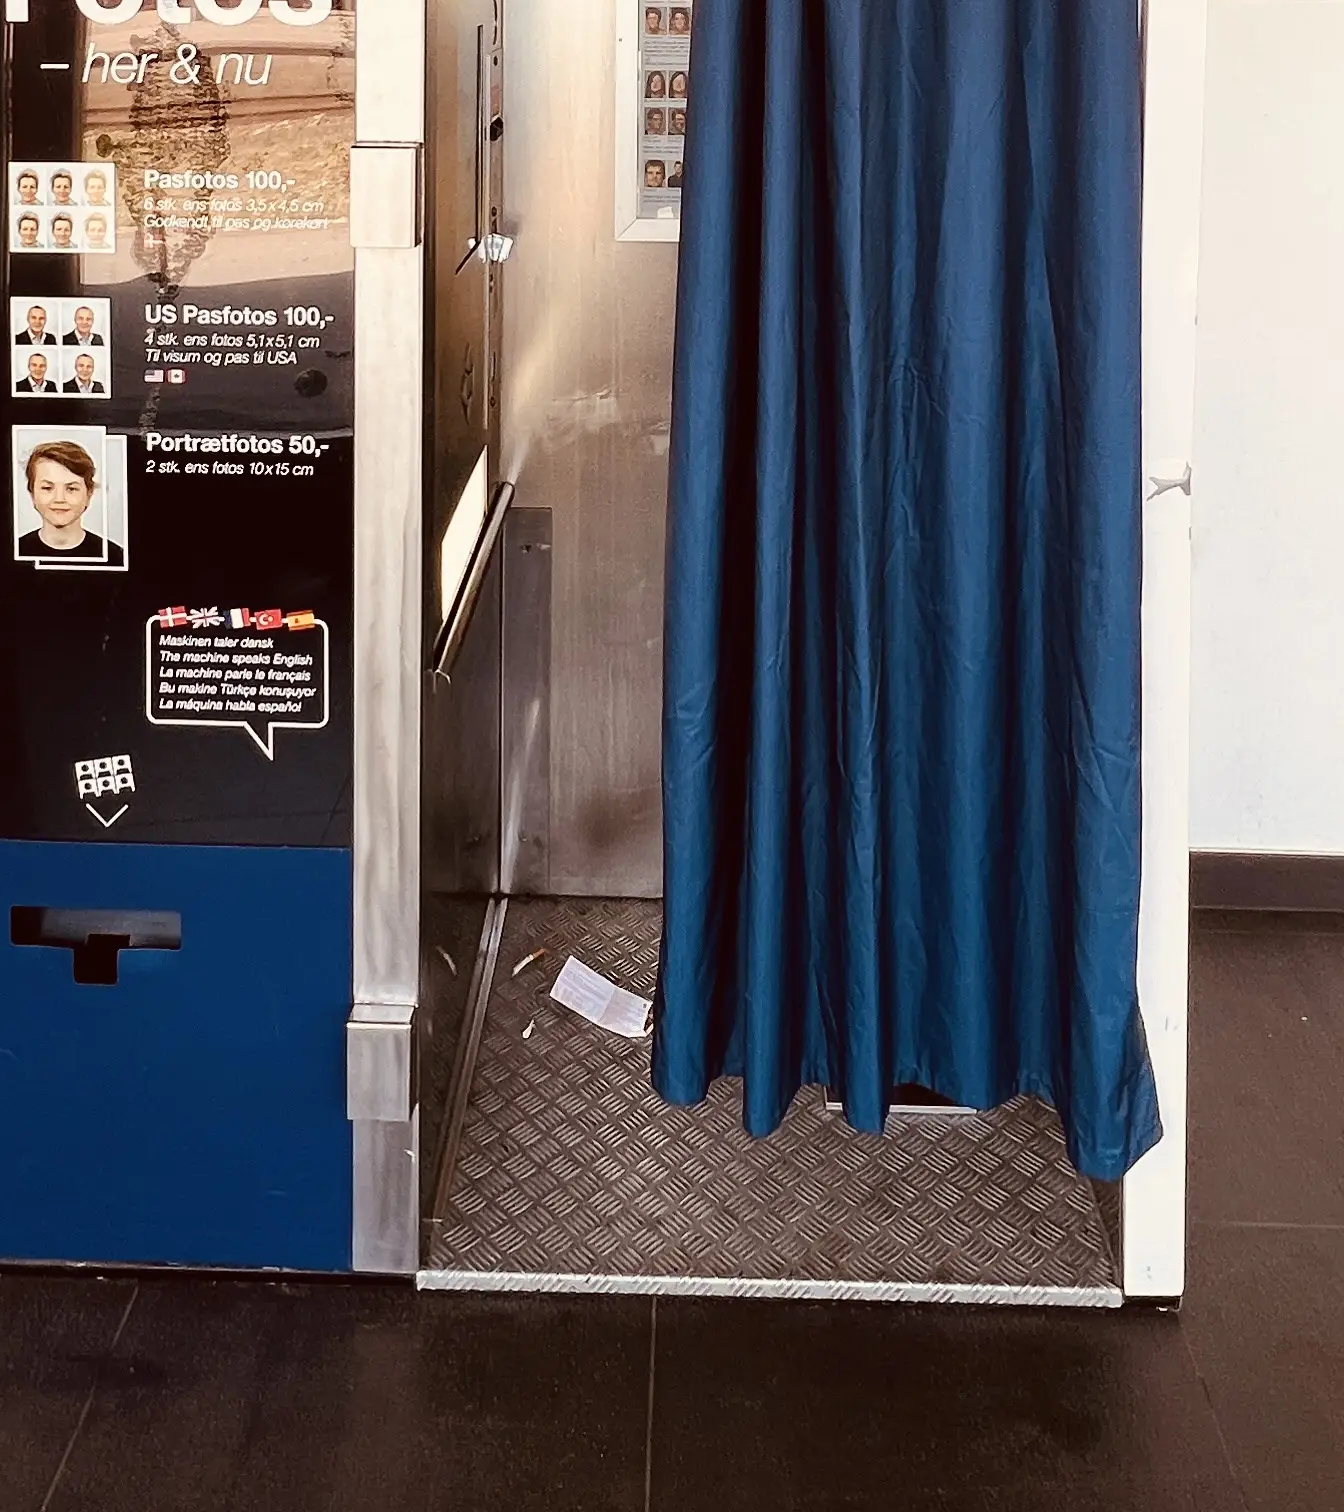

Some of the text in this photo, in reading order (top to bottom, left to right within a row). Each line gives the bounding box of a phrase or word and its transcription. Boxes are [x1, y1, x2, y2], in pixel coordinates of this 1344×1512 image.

[80, 42, 158, 85] her
[169, 43, 201, 86] &
[216, 51, 273, 86] nu
[144, 169, 296, 193] Pasfotos 100,-
[183, 200, 207, 212] ens
[209, 198, 242, 213] fotos
[301, 201, 324, 214] cm
[223, 218, 249, 232] pas
[253, 219, 272, 232] og
[145, 304, 335, 330] US Pasfotos 100,-
[144, 333, 154, 346] 4
[156, 332, 179, 347] stk.
[183, 335, 208, 348] ens
[210, 332, 243, 348] fotos
[297, 336, 321, 349] cm
[145, 348, 298, 367] Til visum og pas til USA
[146, 432, 330, 458] Portrætfotos 50,-
[145, 459, 315, 476] 2 stk. ens fotos 10x15 cm
[158, 634, 275, 649] Maskinen taler dansk
[159, 650, 313, 667] The machine speaks English
[159, 666, 312, 684] La machine parle le français
[158, 681, 317, 700] Bu makine Türkçe konuşuyor
[158, 697, 302, 714] La máquina habla español
